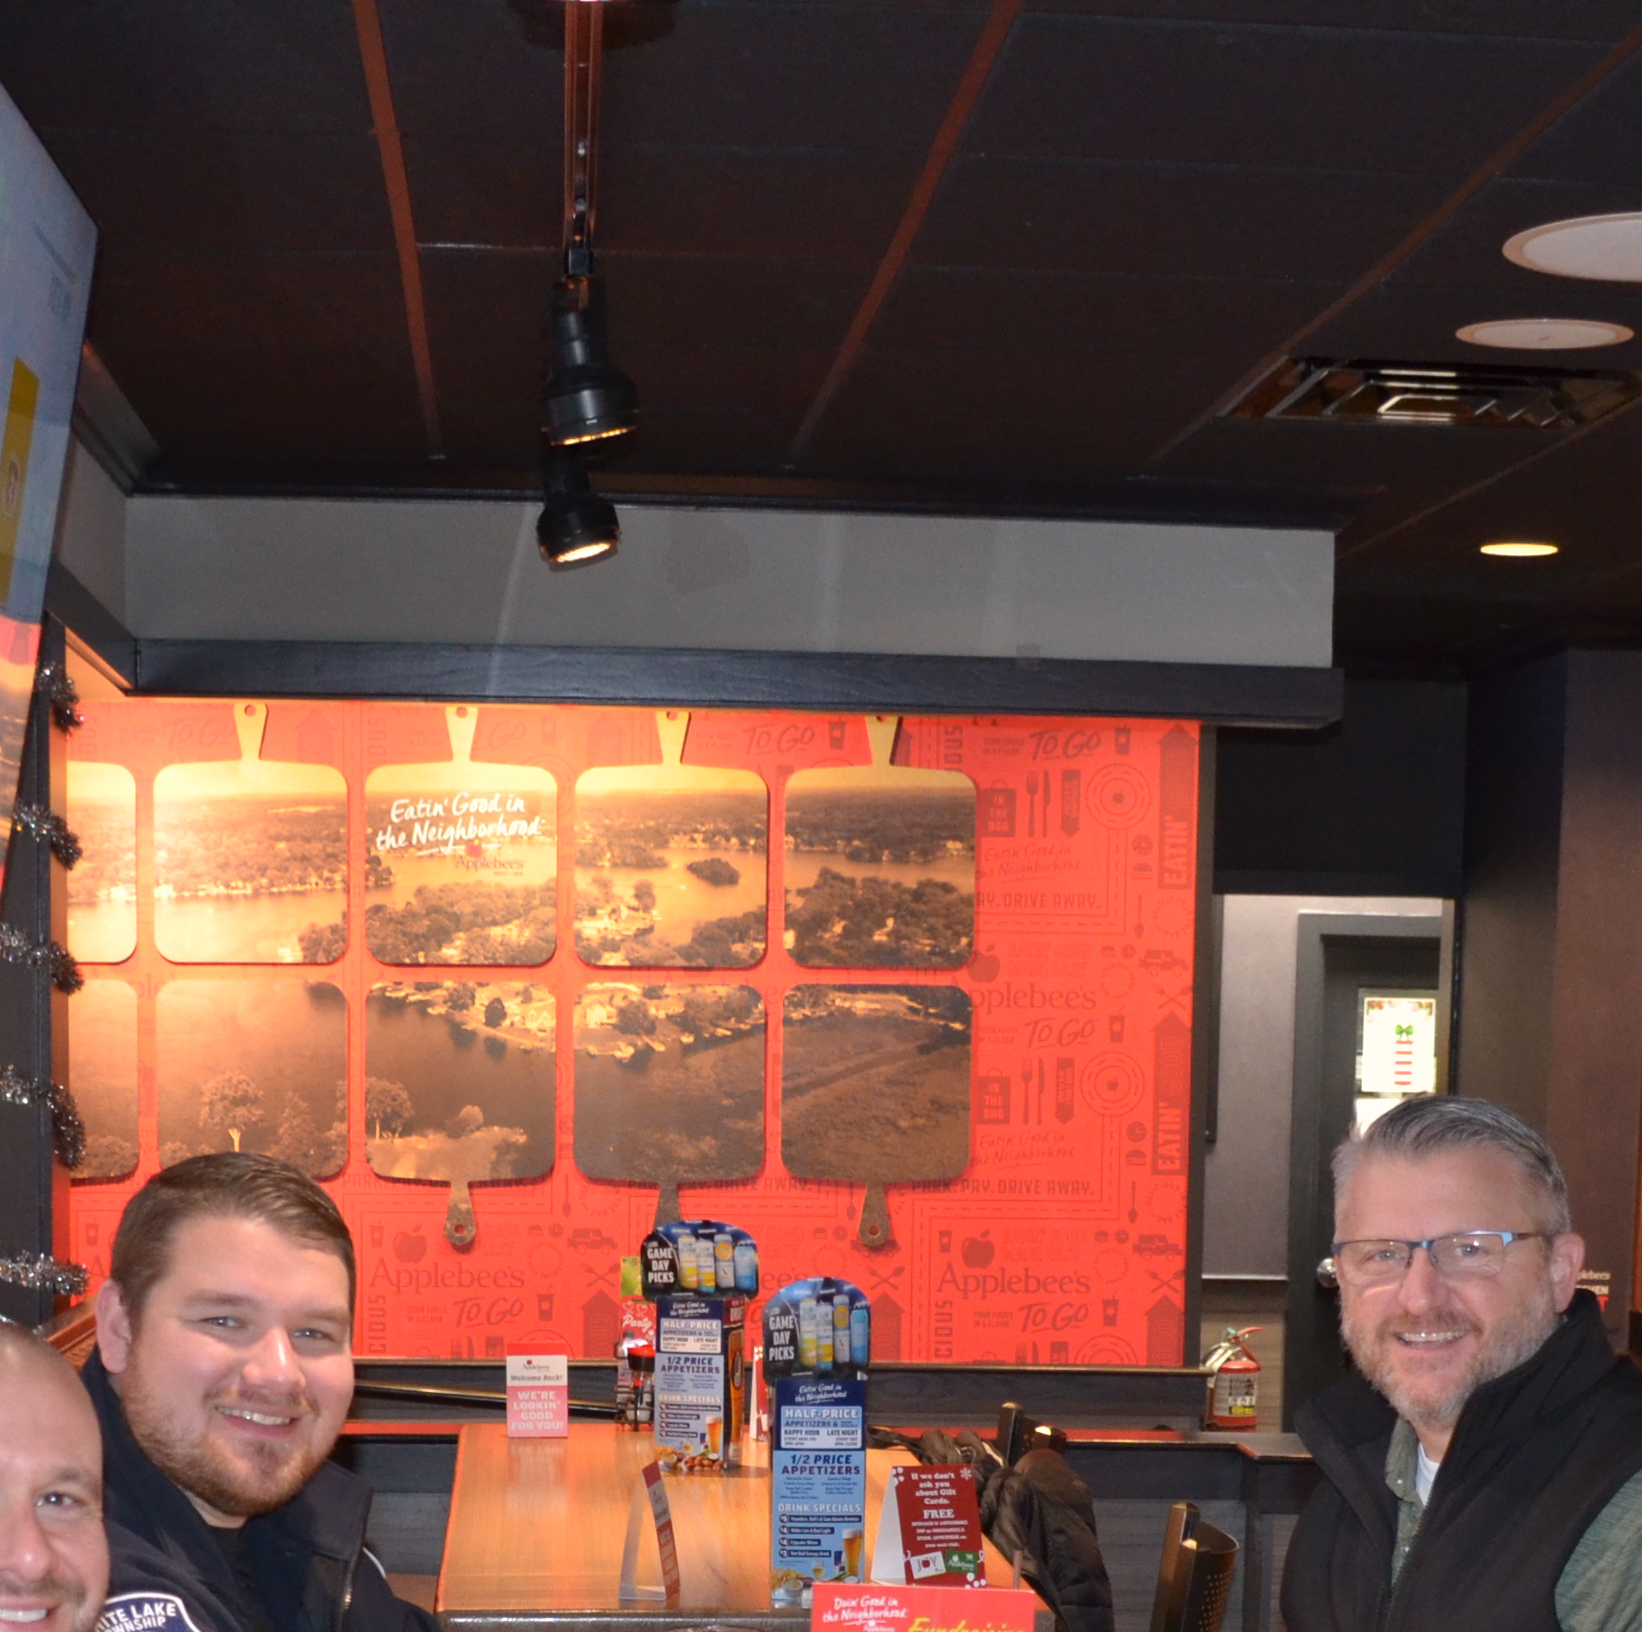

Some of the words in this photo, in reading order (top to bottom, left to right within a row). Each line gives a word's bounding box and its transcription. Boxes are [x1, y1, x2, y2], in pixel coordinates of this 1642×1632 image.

[452, 792, 502, 816] Good
[506, 793, 525, 813] in
[376, 826, 408, 850] the
[412, 816, 542, 854] Neighborhood
[969, 983, 1097, 1015] pplebee's
[998, 1180, 1041, 1195] DRIVE
[647, 1248, 674, 1261] GAME
[651, 1260, 669, 1272] DAY
[370, 1257, 525, 1293] Applebee's
[647, 1271, 675, 1284] PICKS
[937, 1262, 1091, 1299] Applebee's
[769, 1316, 795, 1330] GAME
[772, 1331, 791, 1346] DAY
[768, 1347, 795, 1361] PICKS
[684, 1356, 714, 1366] PRICE
[660, 1365, 721, 1375] APPETIZERS
[791, 1454, 811, 1465] 1/2
[814, 1454, 853, 1465] PRICE
[781, 1465, 861, 1475] APPETIZERS
[778, 1503, 810, 1513] DRINK
[813, 1502, 862, 1513] SPECIALS
[923, 1508, 955, 1520] FREE
[131, 1602, 177, 1619] LAKE
[823, 1611, 840, 1623] the
